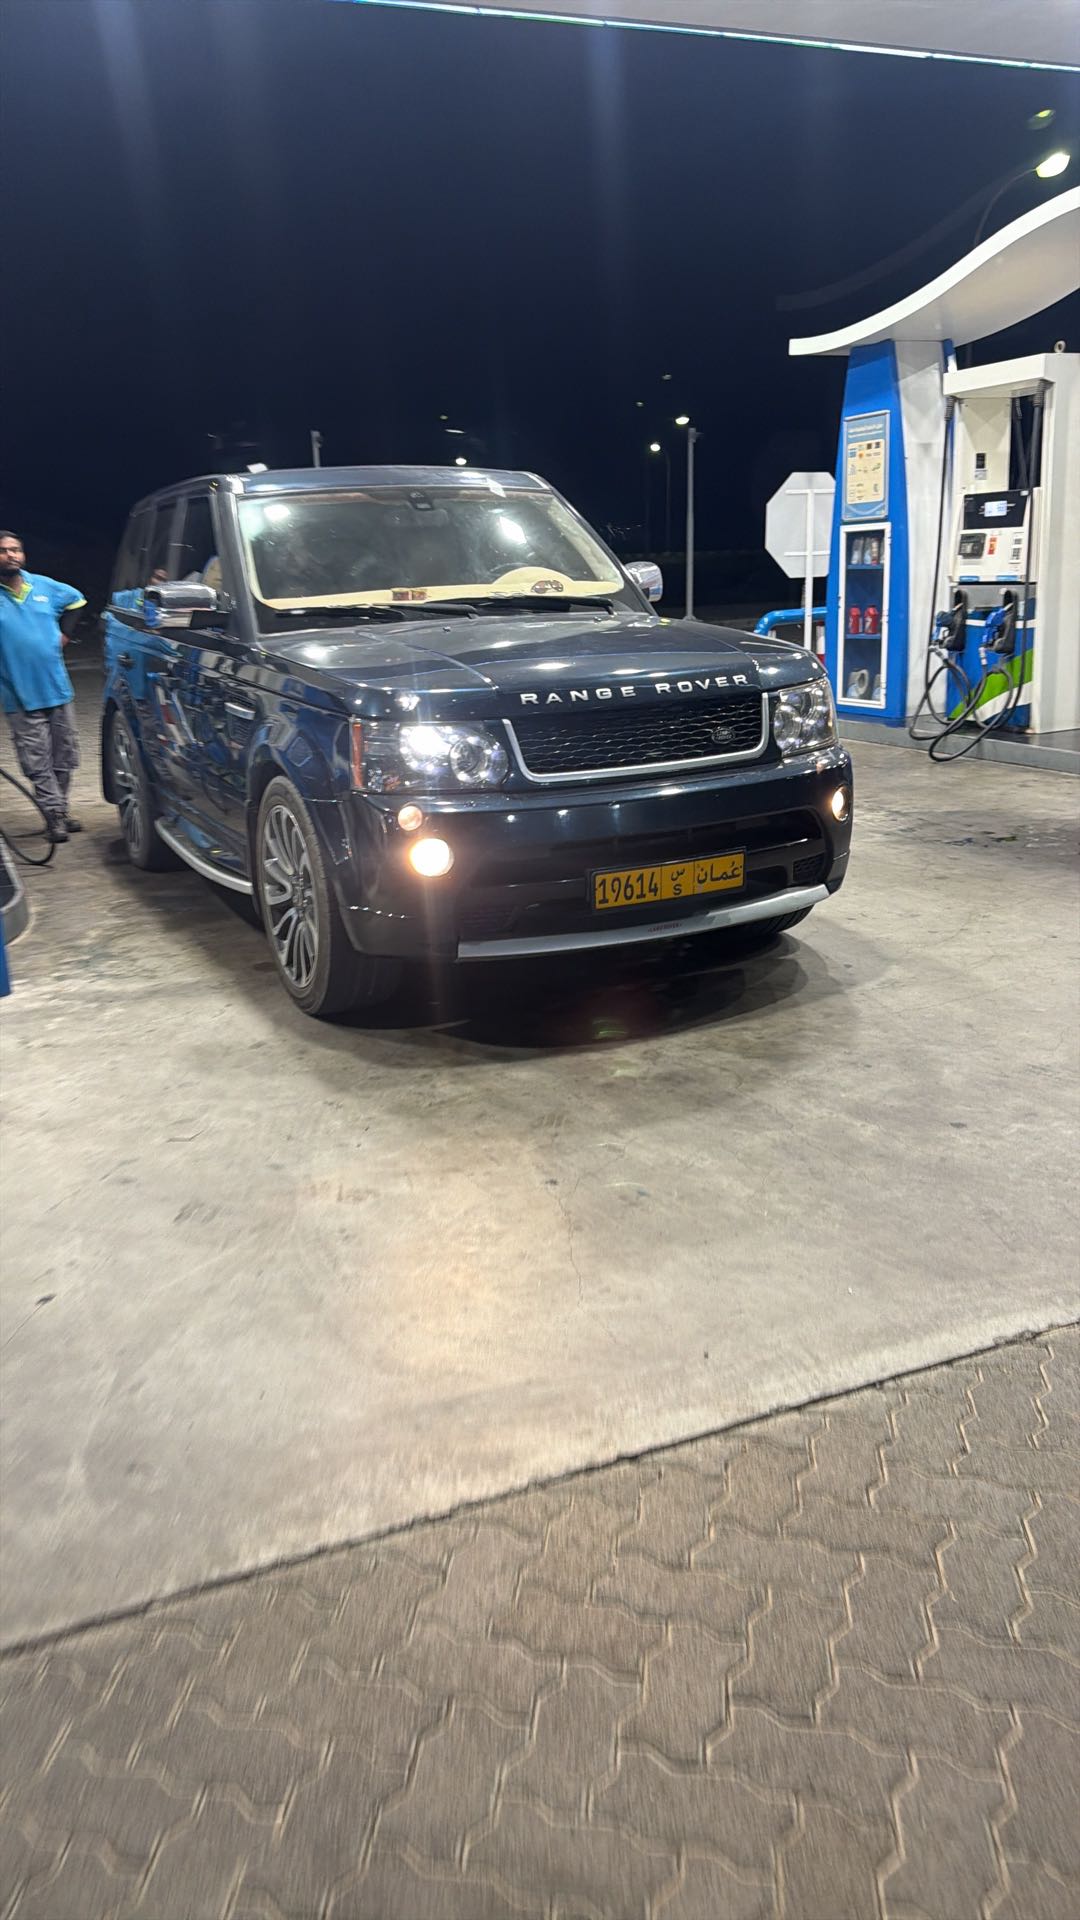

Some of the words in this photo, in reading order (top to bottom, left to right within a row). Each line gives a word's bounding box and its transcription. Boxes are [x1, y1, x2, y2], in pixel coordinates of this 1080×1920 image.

[519, 685, 637, 705] RANGE
[654, 674, 749, 695] ROVER
[670, 867, 686, 882] س
[598, 871, 659, 905] 19614
[672, 883, 682, 896] S
